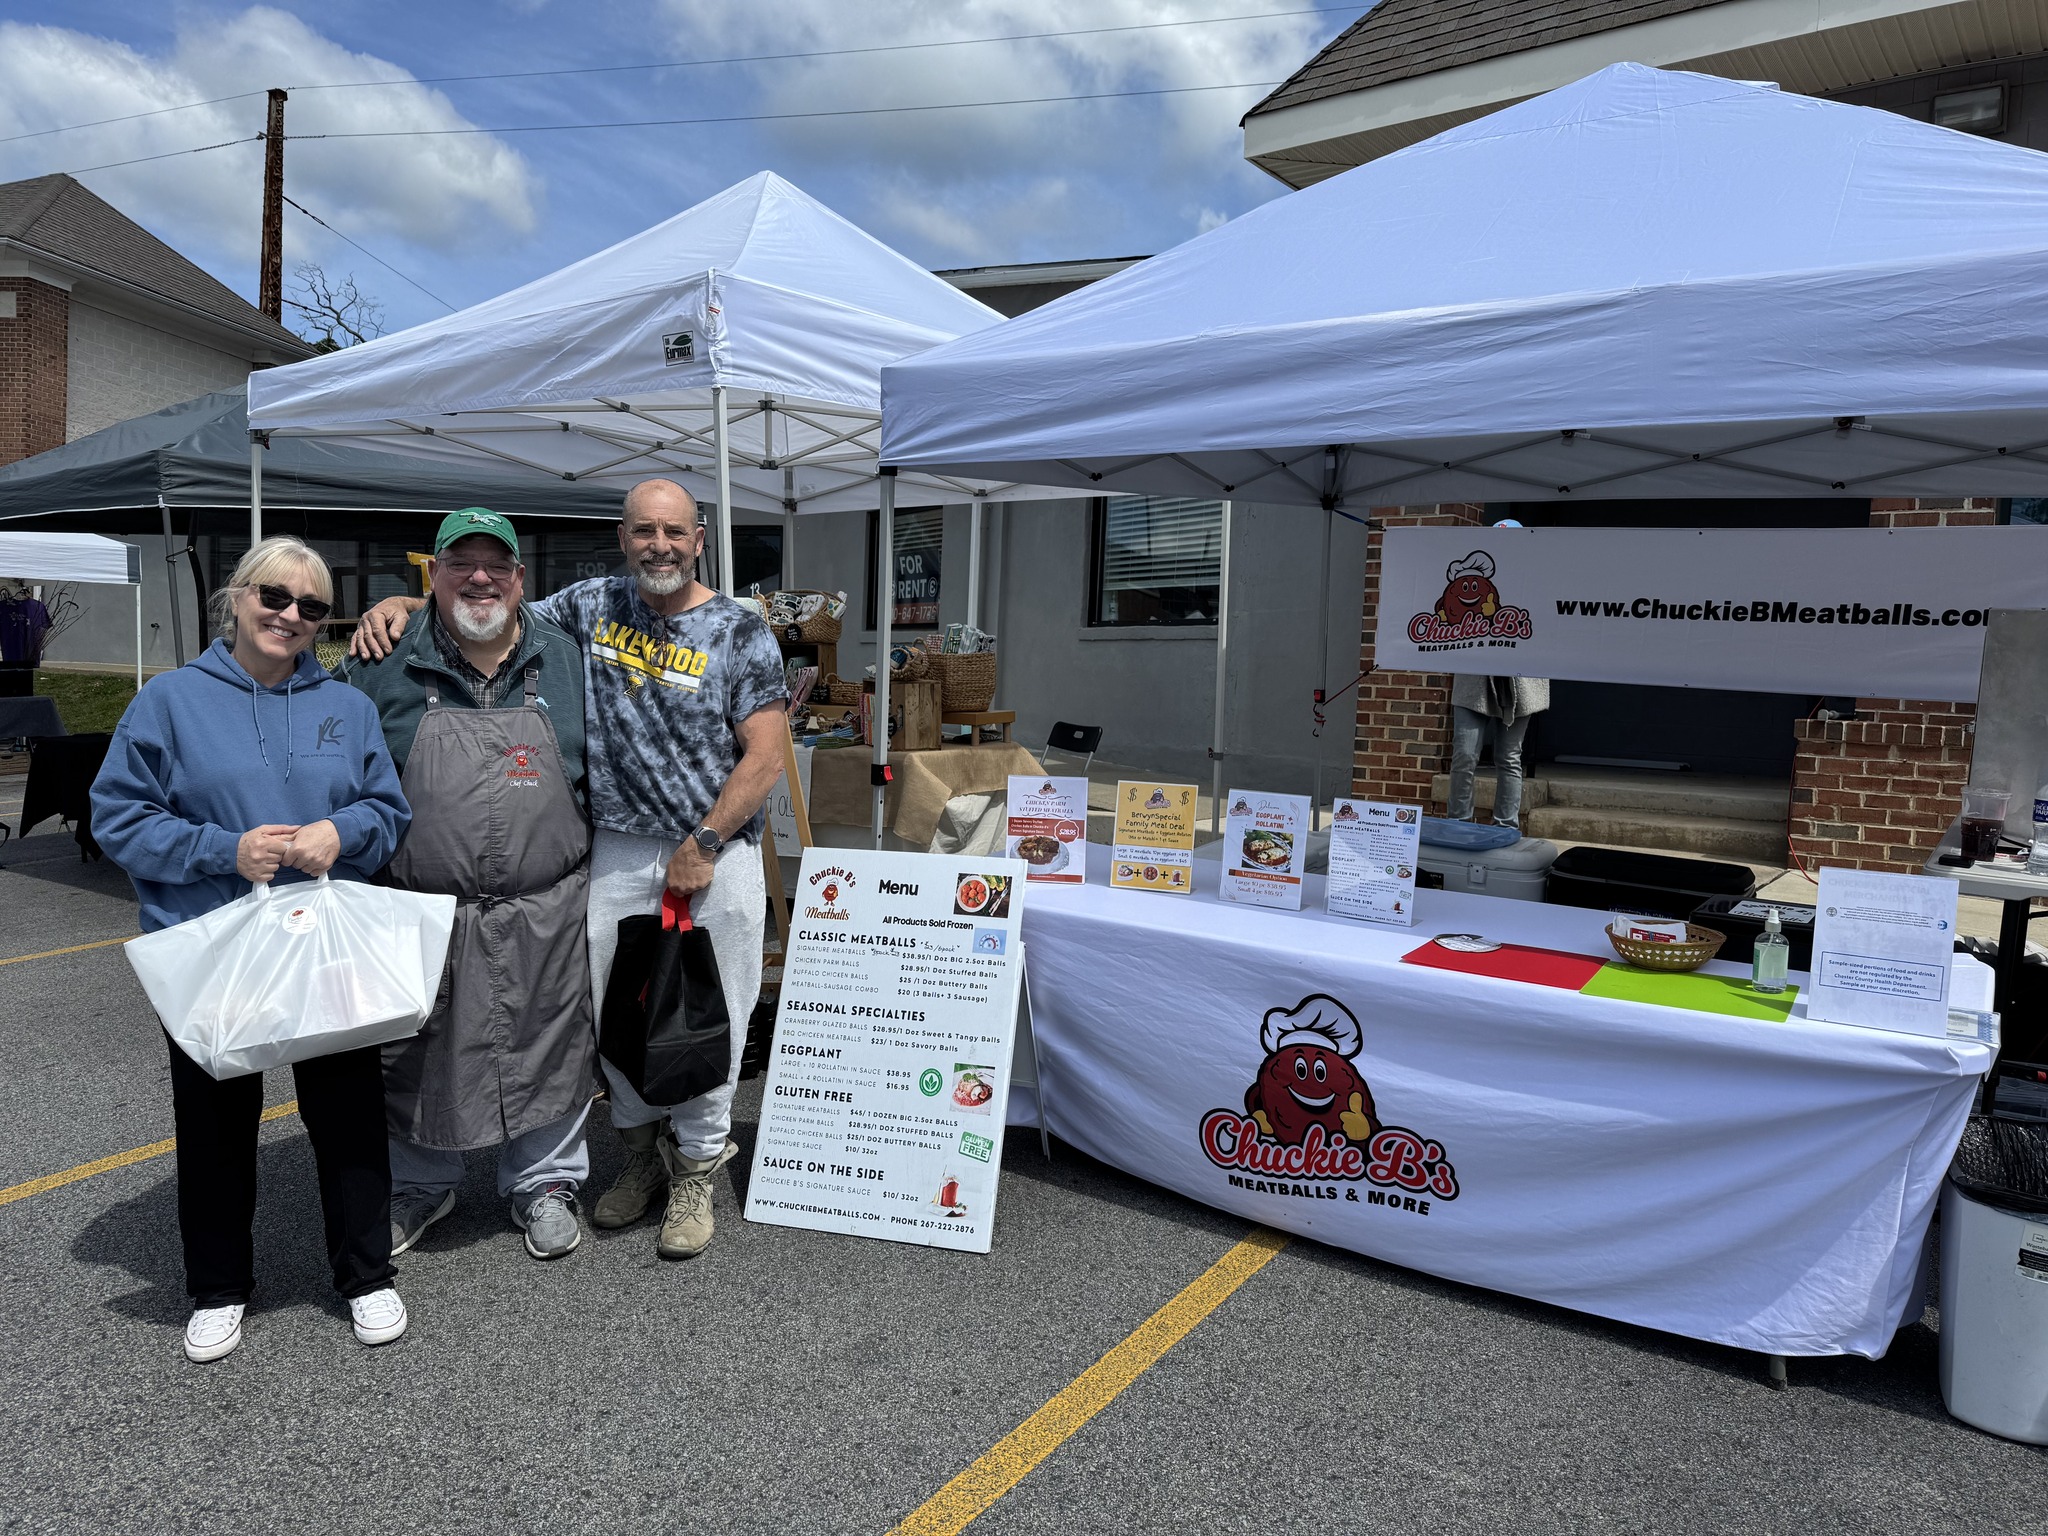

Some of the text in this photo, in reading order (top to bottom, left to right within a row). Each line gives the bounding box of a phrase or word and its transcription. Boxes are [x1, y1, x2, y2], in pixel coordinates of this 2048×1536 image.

[899, 555, 923, 575] FOR
[898, 579, 928, 599] RENT
[1408, 606, 1532, 643] Chuckie B's
[1417, 639, 1517, 652] MEATBALLS & MORE
[1255, 812, 1286, 821] EGGPLANT
[1368, 807, 1390, 817] Menu
[1125, 819, 1149, 829] Family
[1255, 820, 1285, 829] ROLLATINI
[809, 865, 857, 888] Chuckie B's
[878, 878, 919, 896] Menu
[803, 905, 851, 921] Meatballs
[882, 915, 974, 930] All Products Sold Frozen
[798, 929, 916, 948] CLASSIC MEATBALLS
[796, 944, 830, 952] SIGNATURE
[831, 946, 866, 955] MEATBALLS
[933, 954, 948, 962] Doz
[965, 957, 985, 965] 2.5oz
[987, 959, 1006, 967] Balls
[794, 956, 821, 964] CHICKEN
[948, 968, 976, 977] Stuffed
[1868, 971, 1895, 979] regulated
[790, 979, 852, 991] MEATBALL-SAUSAGE
[854, 985, 879, 993] COMBO
[897, 988, 910, 996] $20
[792, 968, 819, 976] BUFFALO
[822, 970, 848, 979] CHICKEN
[922, 978, 936, 986] Doz
[938, 980, 967, 989] Buttery
[969, 982, 988, 990] Balls
[1854, 975, 1874, 983] County
[786, 999, 925, 1022] SEASONAL SPECIALTIES
[784, 1016, 820, 1026] CRANBERRY
[822, 1020, 847, 1028] GLAZED
[849, 1022, 868, 1030] BALLS
[905, 1028, 919, 1036] Doz
[921, 1030, 945, 1038] Sweet
[954, 1033, 978, 1043] Tangy
[980, 1035, 1000, 1043] Balls
[780, 1043, 841, 1059] EGGPLANT
[796, 1030, 824, 1039] CHICKEN
[826, 1033, 861, 1042] MEATBALLS
[910, 1041, 936, 1051] Savory
[938, 1044, 958, 1052] Balls
[780, 1058, 911, 1078] LARGE ROLLATINI SAUCE $38.95
[778, 1070, 909, 1091] SMALL ROLLATINI SAUCE $16.95
[774, 1084, 853, 1103] GLUTEN FREE
[772, 1101, 806, 1111] SIGNATURE
[807, 1105, 840, 1115] MEATBALLS
[872, 1111, 897, 1120] DOZEN
[913, 1116, 932, 1124] 2.5oz
[935, 1118, 958, 1126] BALLS
[770, 1114, 797, 1123] CHICKEN
[798, 1116, 815, 1124] PARM
[816, 1119, 834, 1127] BALLS
[878, 1124, 894, 1132] DOZ
[896, 1126, 928, 1136] STUFFED
[930, 1130, 953, 1139] BALLS
[767, 1138, 800, 1148] SIGNATURE
[801, 1142, 822, 1150] SAUCE
[861, 1147, 878, 1155] 32oz
[768, 1126, 795, 1135] BUFFALO
[797, 1129, 823, 1138] CHICKEN
[824, 1132, 843, 1140] BALLS
[867, 1135, 882, 1143] DOZ
[884, 1137, 916, 1147] BUTTERY
[918, 1141, 941, 1150] BALLS
[961, 1142, 987, 1158] FREE
[1200, 1109, 1460, 1200] Chuckie B's
[762, 1155, 884, 1181] SAUCE ON THE SIDE
[760, 1175, 790, 1186] CHUCKIE
[805, 1181, 845, 1193] SIGNATURE
[847, 1186, 871, 1196] SAUCE
[901, 1193, 918, 1202] 32oz
[1228, 1174, 1431, 1216] MEATBALLS & MORE
[754, 1198, 975, 1234] WWW.CHUCKIEBMEATBALLS.COM PHONE 267-222-2876
